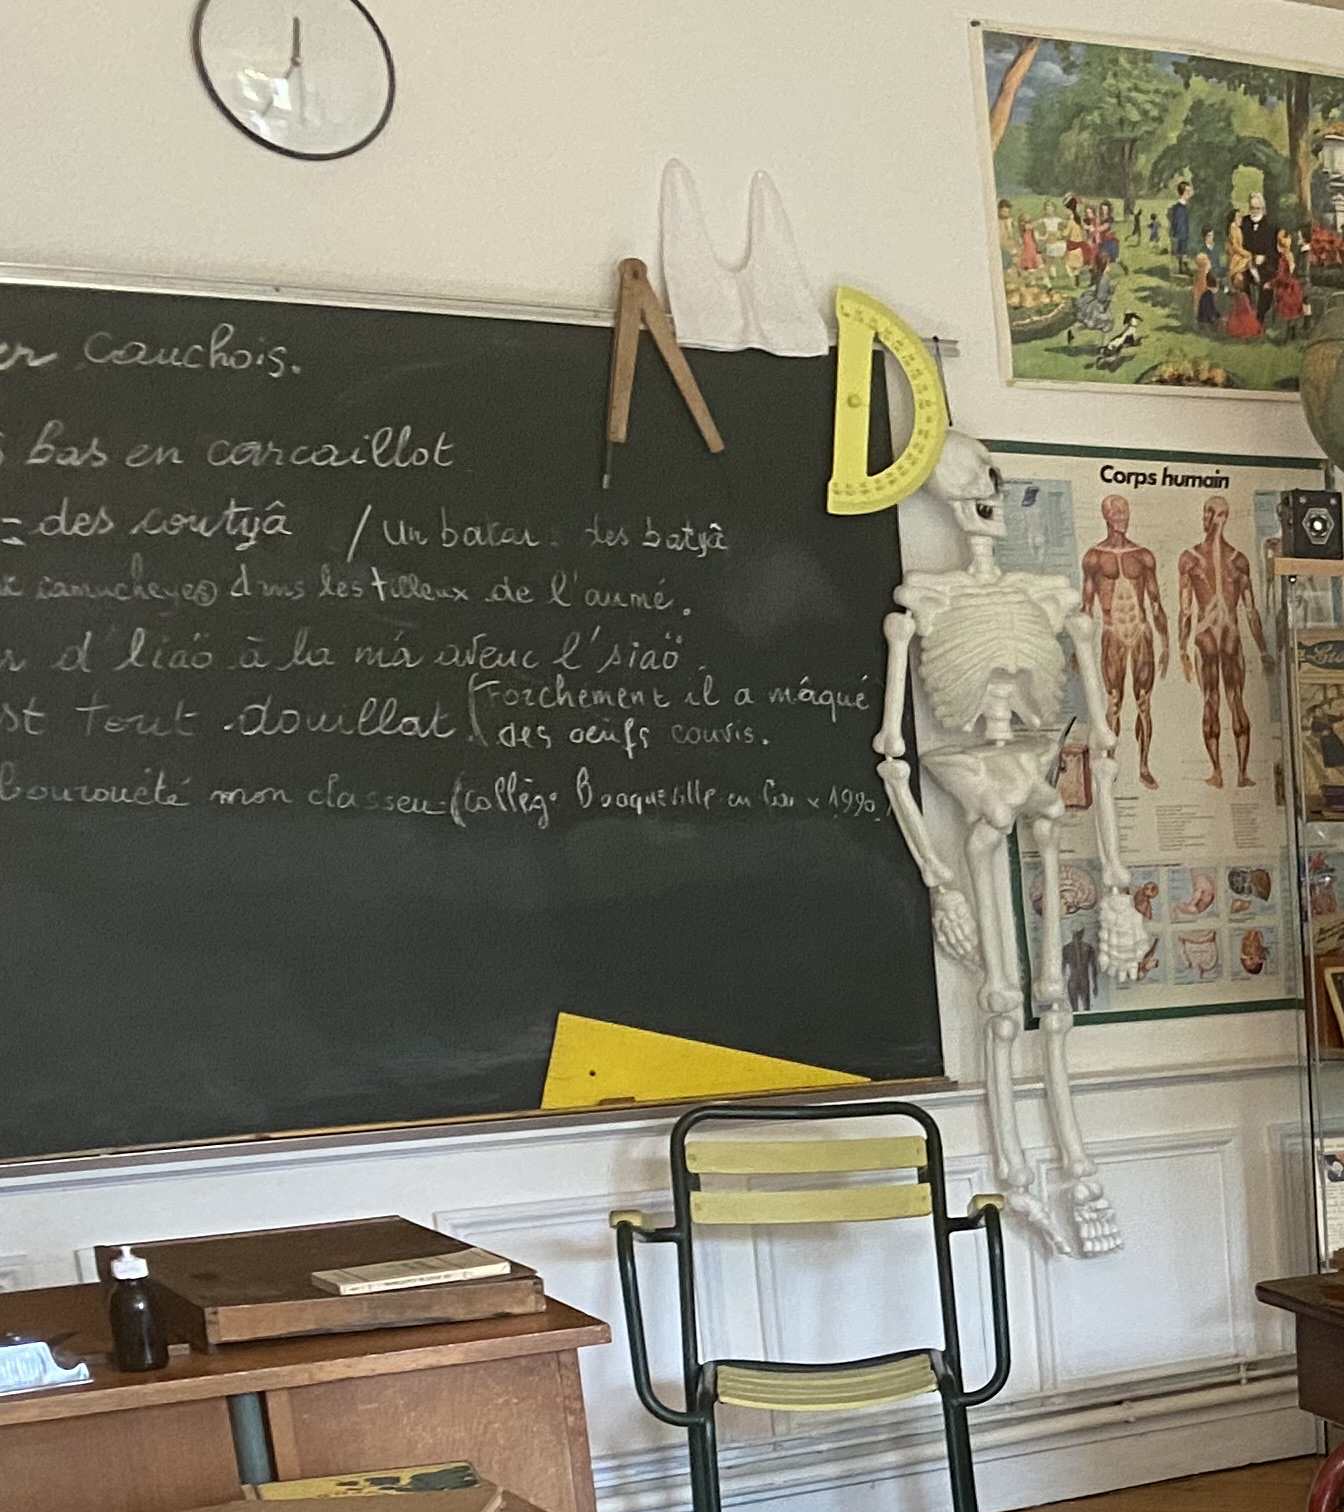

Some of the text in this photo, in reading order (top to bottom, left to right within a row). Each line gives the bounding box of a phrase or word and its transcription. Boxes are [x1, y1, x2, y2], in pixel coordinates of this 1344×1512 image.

[125, 444, 183, 467] en
[1100, 464, 1230, 489] Corps humain
